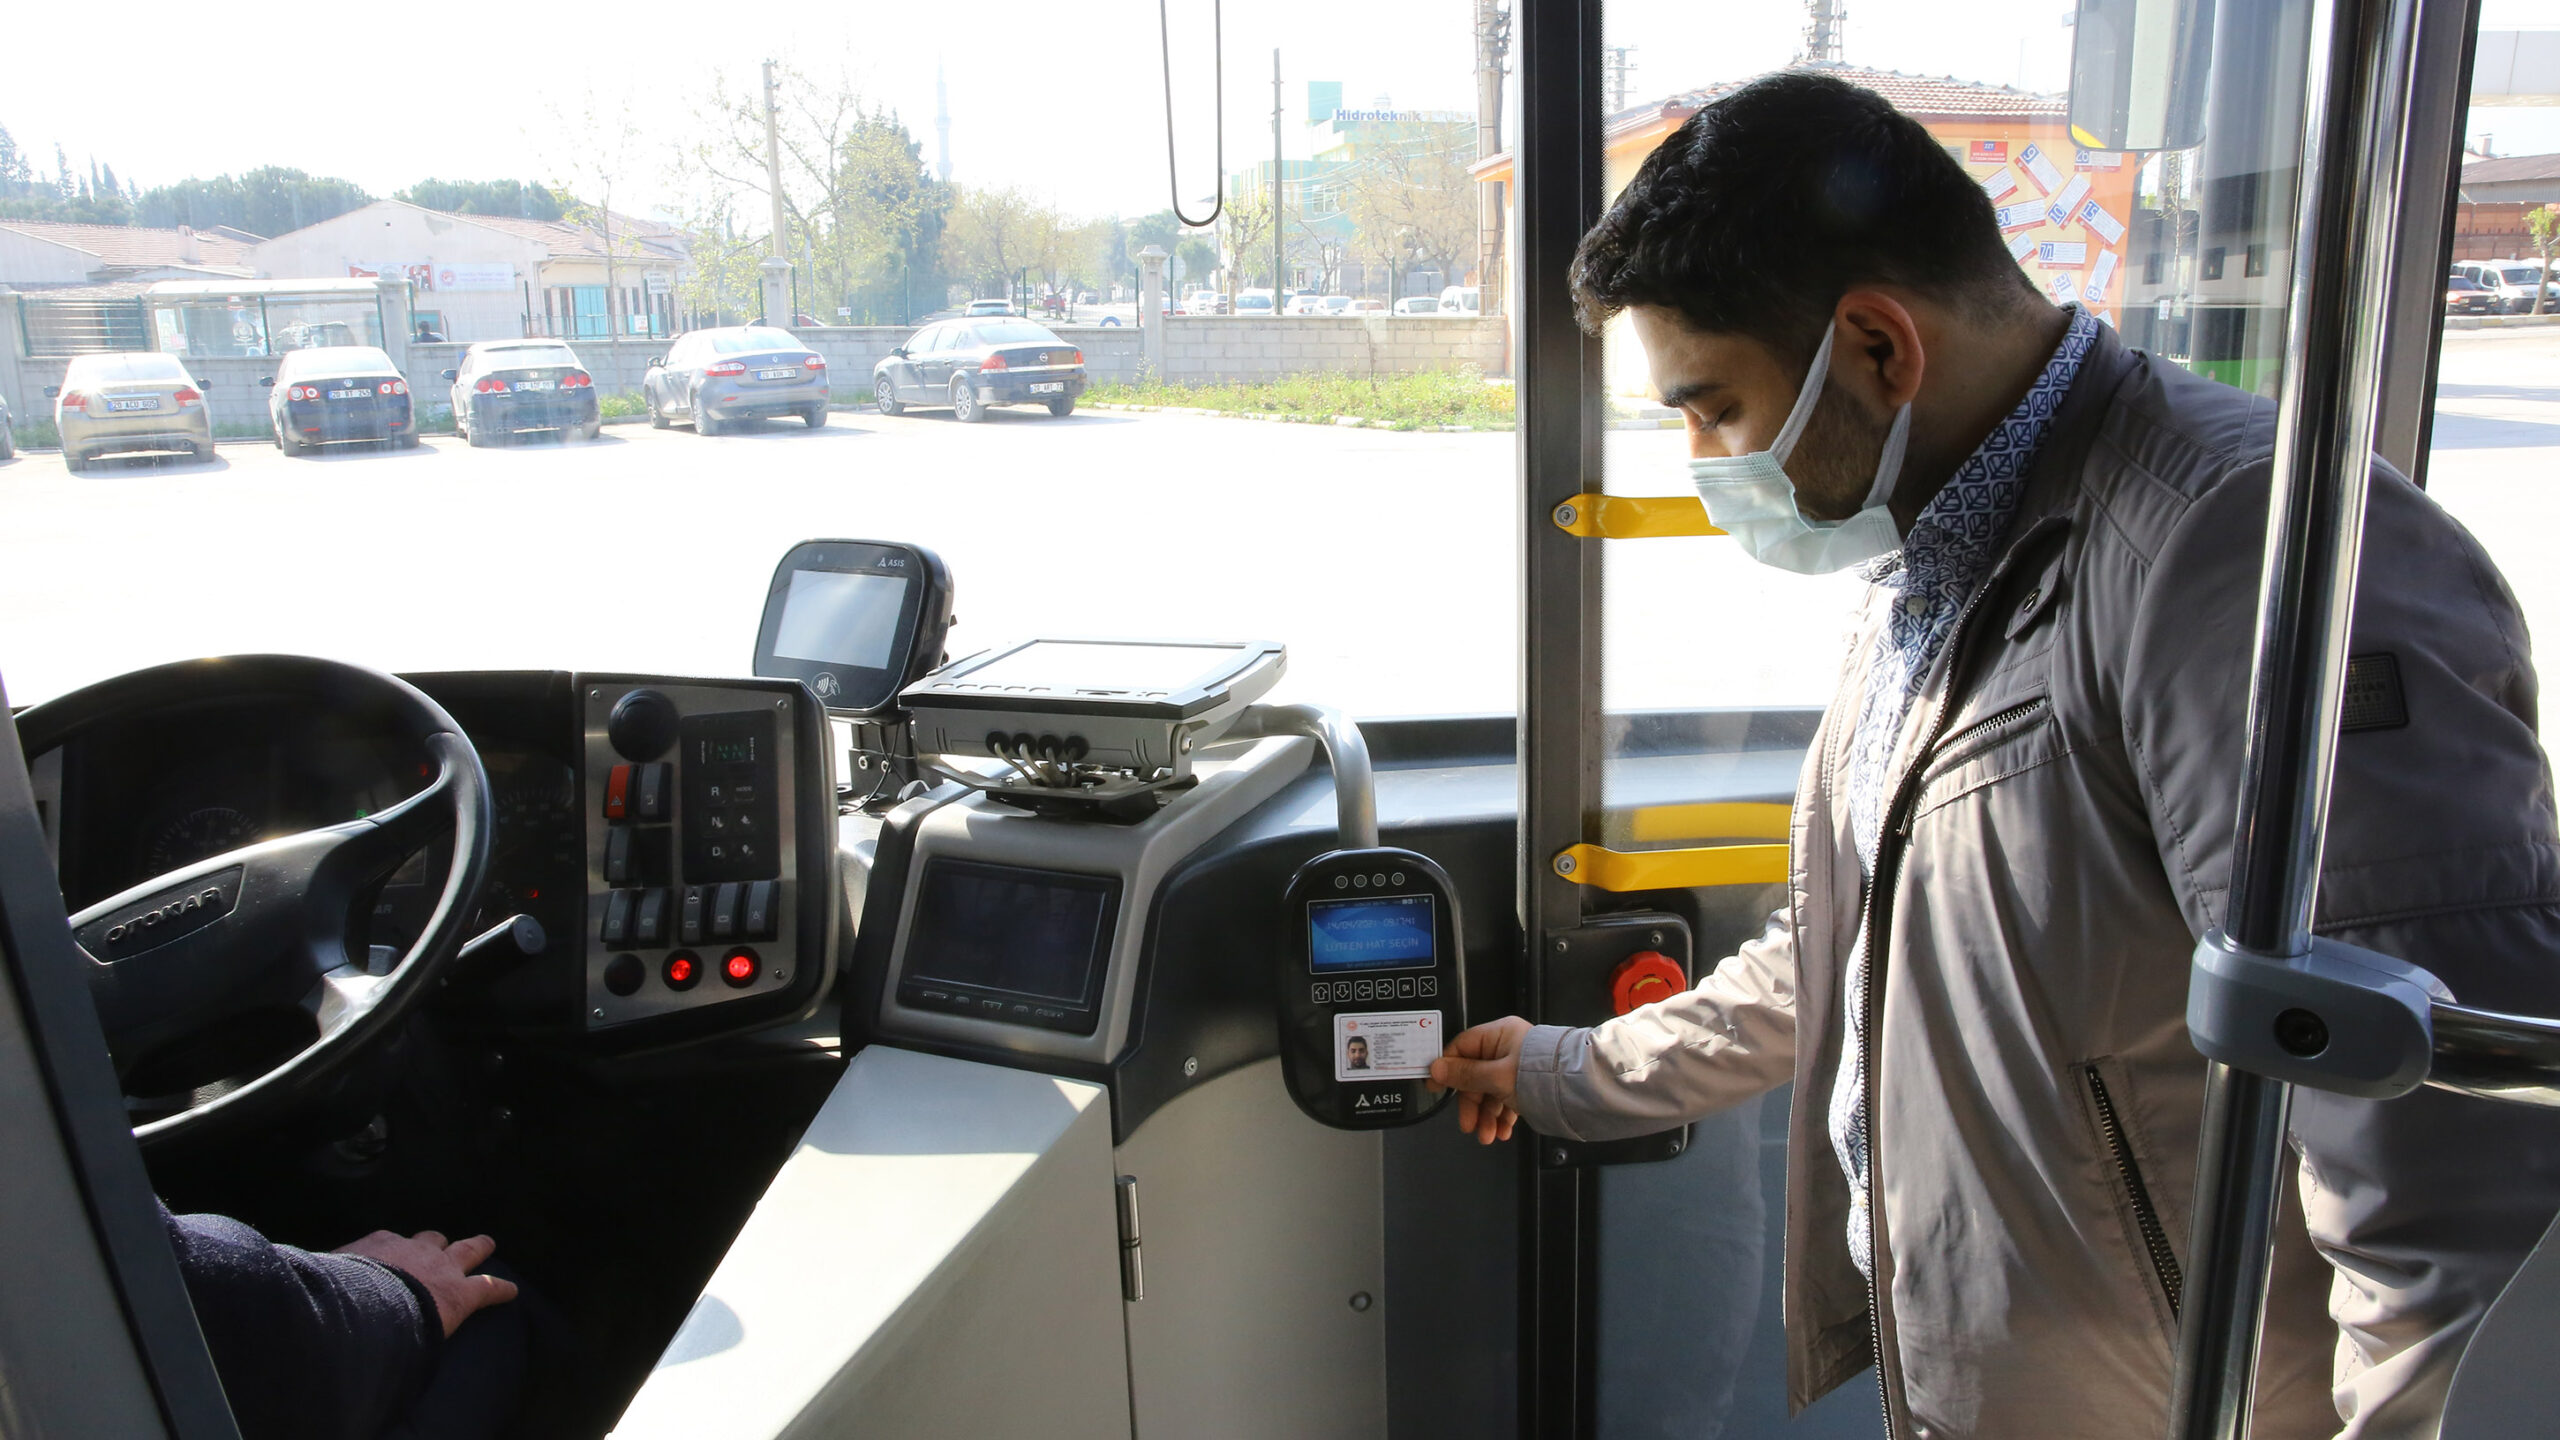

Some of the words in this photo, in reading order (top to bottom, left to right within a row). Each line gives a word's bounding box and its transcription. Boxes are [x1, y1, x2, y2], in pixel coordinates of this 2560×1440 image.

[1336, 109, 1422, 122] Hidroteknik
[2023, 146, 2036, 161] 9
[2049, 205, 2065, 224] 10
[2081, 201, 2098, 221] 15
[1996, 209, 2011, 226] 30
[888, 559, 905, 568] ASIS
[711, 786, 720, 797] R
[711, 816, 721, 827] N
[712, 846, 721, 857] D
[104, 887, 221, 944] OTOKAR
[1366, 939, 1385, 950] HAT
[1401, 984, 1411, 992] OK
[1373, 1093, 1402, 1105] ASIS
